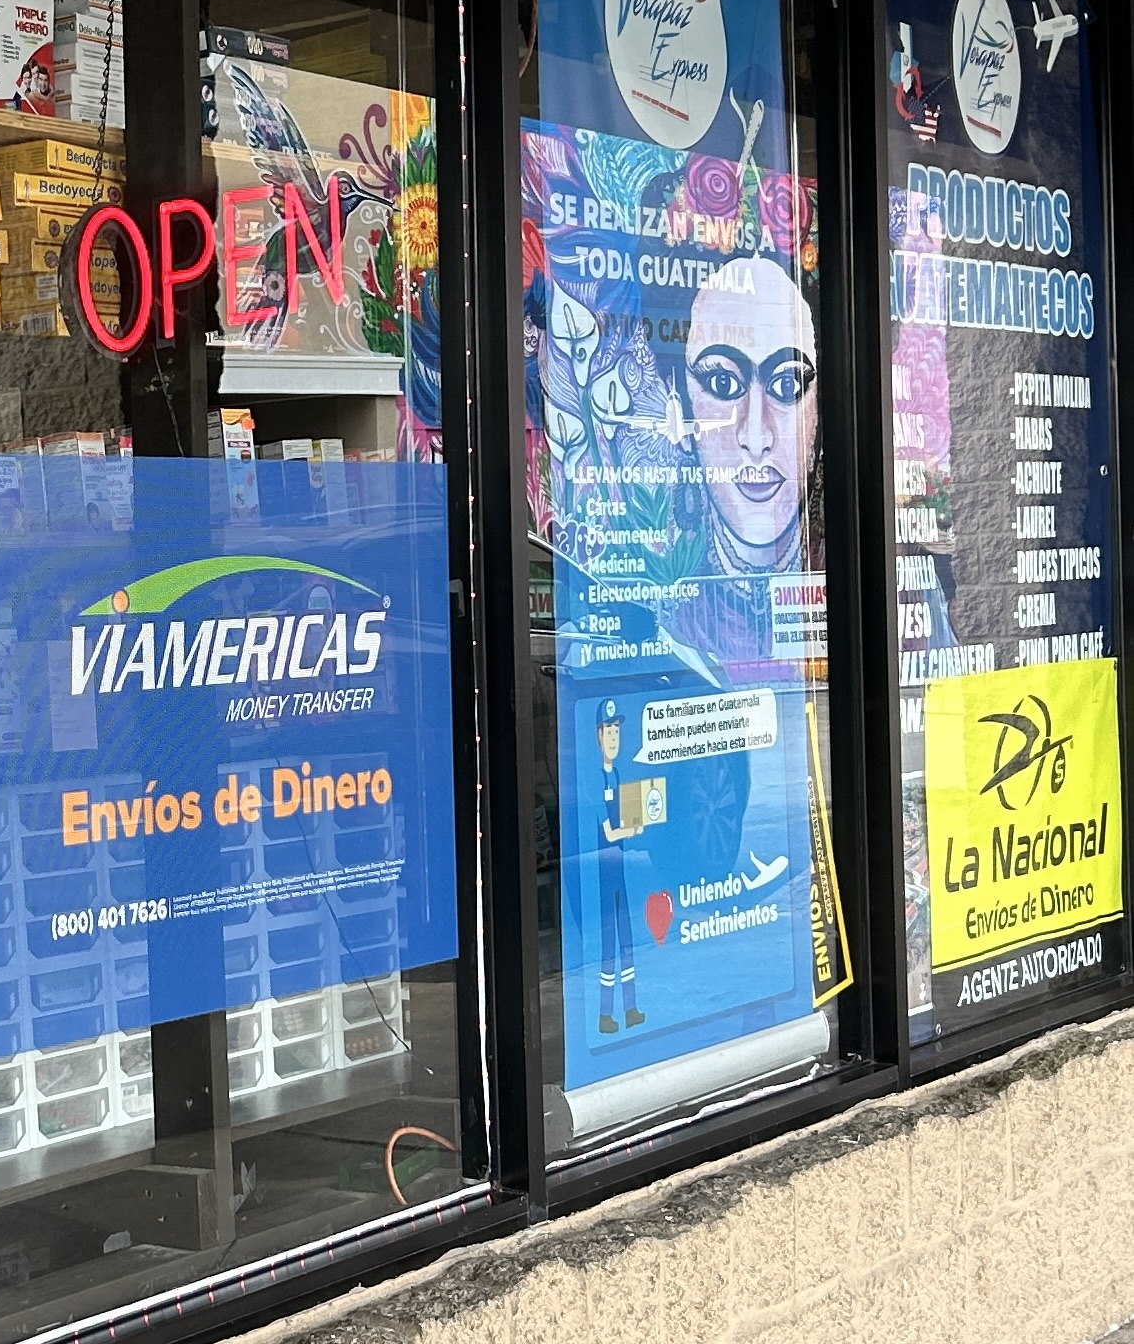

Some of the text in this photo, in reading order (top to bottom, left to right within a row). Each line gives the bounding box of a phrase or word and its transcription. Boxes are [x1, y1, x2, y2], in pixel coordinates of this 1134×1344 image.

[15, 20, 49, 37] HIERRO
[16, 6, 47, 22] TRIPLE
[652, 32, 708, 101] Express
[550, 193, 577, 226] SE
[761, 225, 775, 253] A
[907, 162, 1072, 257] PRODUCTOS
[77, 174, 344, 353] OPEN
[575, 246, 755, 296] TODA GUATEMALA
[1053, 375, 1092, 409] MOLIDA
[572, 466, 769, 484] LLEVAMOS HASTA TUS FAMILIARES
[586, 498, 627, 517] Cartas
[587, 527, 667, 545] Documentos
[587, 554, 646, 575] Medicina
[589, 614, 621, 636] Ropa
[71, 611, 387, 696] VIAMERICAS
[596, 640, 638, 661] mucho
[226, 687, 375, 723] MONEY TRANSFER
[646, 707, 664, 720] Tus
[706, 702, 717, 713] en
[718, 694, 760, 711] Guatemala
[687, 720, 716, 739] pueden
[647, 743, 706, 761] encomiendas
[707, 737, 727, 753] hacia
[729, 736, 746, 749] esta
[61, 760, 393, 847] Envíos de Dinero
[944, 802, 1109, 894] La Nacional
[679, 873, 742, 908] Uniendo
[51, 898, 168, 941] (800) 401 7626
[679, 901, 779, 945] Sentimientos
[966, 882, 1095, 940] Envíos de Dinero
[958, 934, 1102, 1007] AGENTE AUTORIZADO
